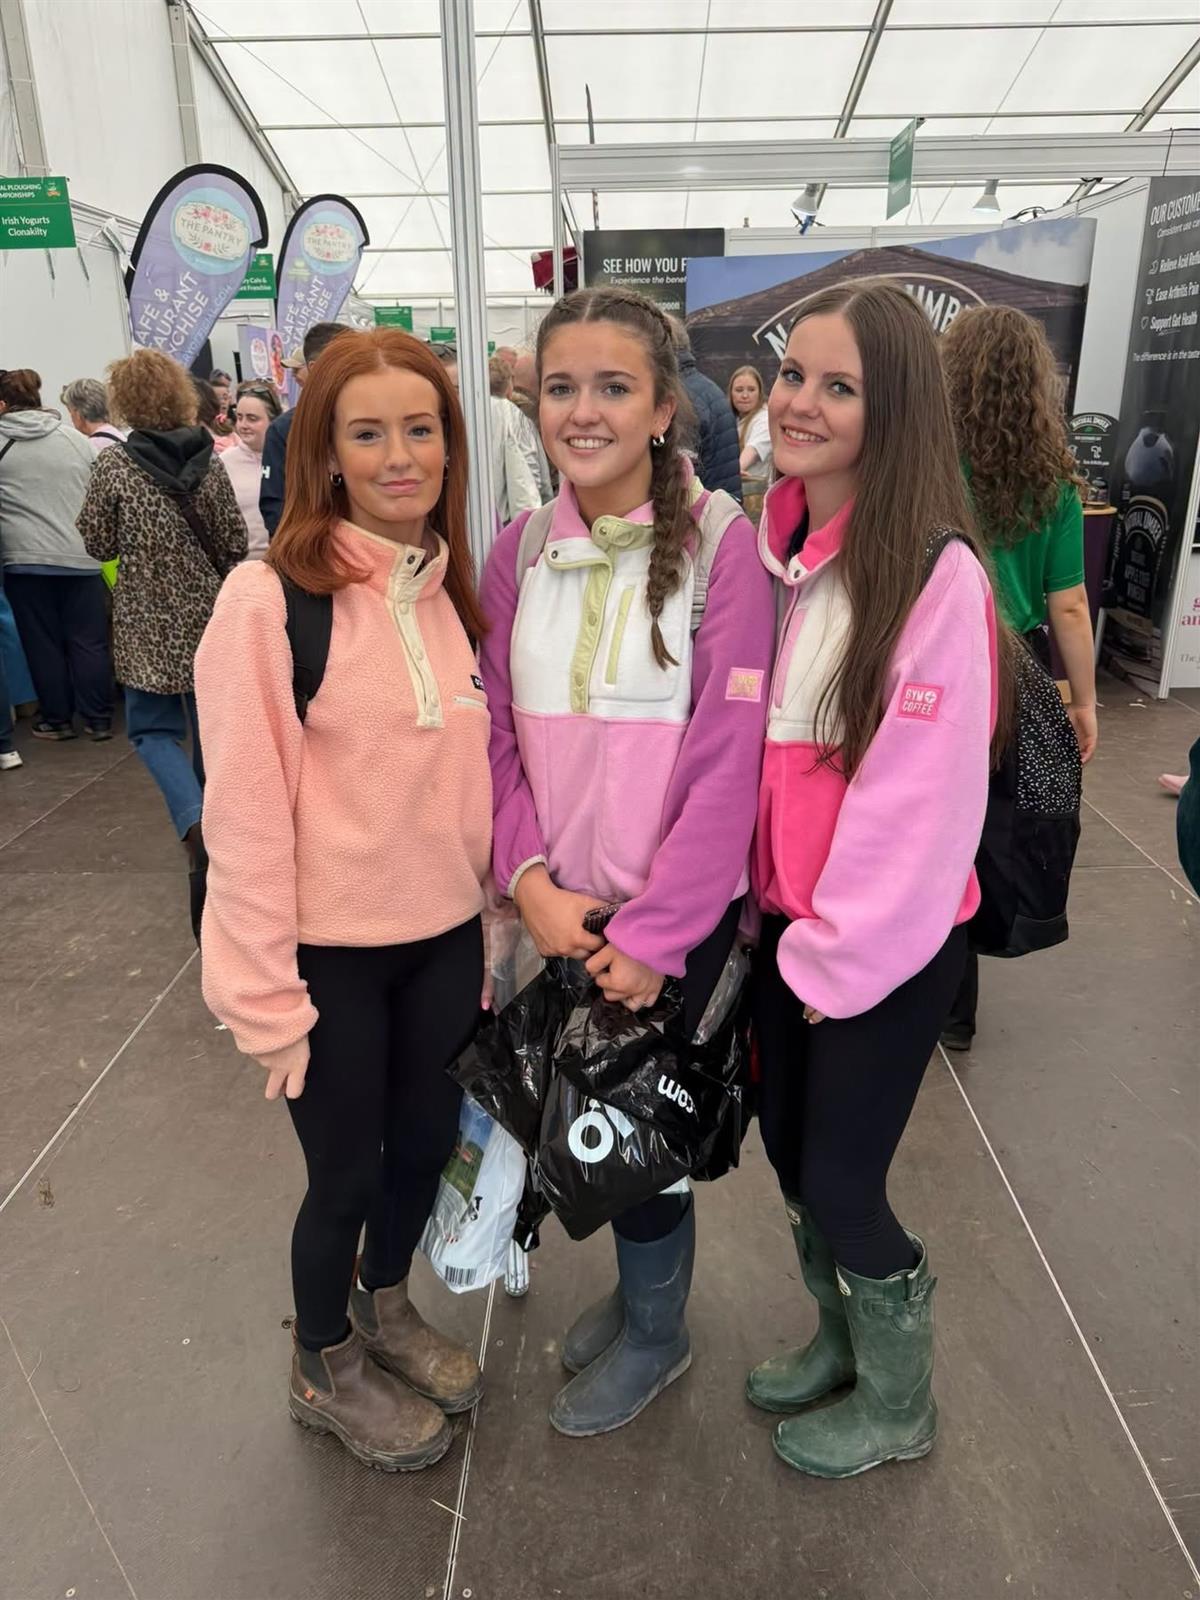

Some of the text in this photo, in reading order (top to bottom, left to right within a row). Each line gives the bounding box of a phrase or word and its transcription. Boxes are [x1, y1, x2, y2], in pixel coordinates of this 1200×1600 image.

[1, 216, 50, 226] Irish Yogurts
[1150, 203, 1167, 226] OUR
[8, 227, 47, 237] Clonakilty
[181, 218, 242, 246] THE PANTRY
[603, 257, 687, 274] SEE HOW YOU F
[610, 276, 687, 286] Experience the benef
[1155, 287, 1168, 302] Ease
[1188, 281, 1200, 296] Pain
[135, 287, 170, 344] AFÉ &
[283, 291, 305, 345] CAFÉ &
[292, 275, 324, 343] TAURANT
[1150, 310, 1197, 332] Support Gut Health
[902, 700, 933, 716] COFFEE
